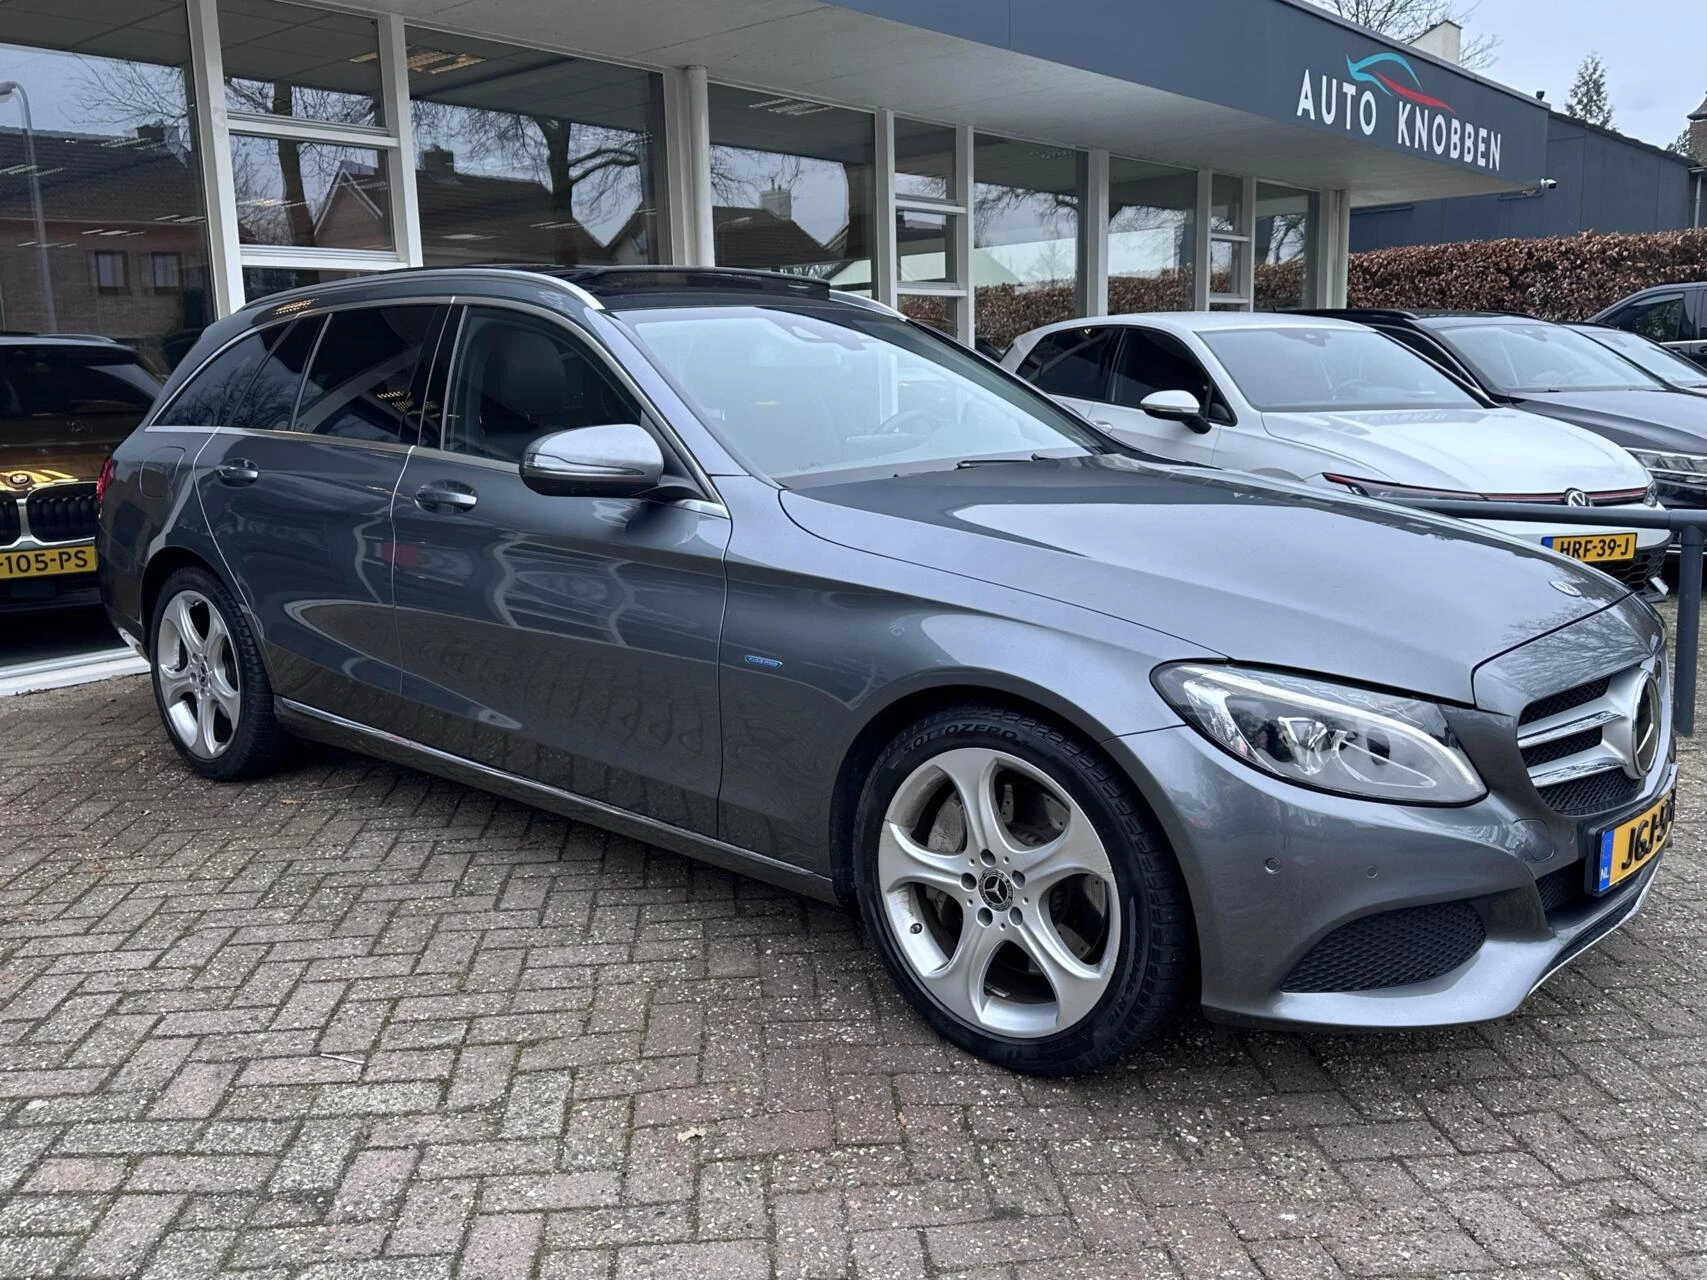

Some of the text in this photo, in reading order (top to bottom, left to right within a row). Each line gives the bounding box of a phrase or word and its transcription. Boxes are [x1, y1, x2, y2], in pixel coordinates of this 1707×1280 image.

[1296, 69, 1502, 171] AUTO KNOBBEN
[1560, 538, 1630, 559] HRF-39-J
